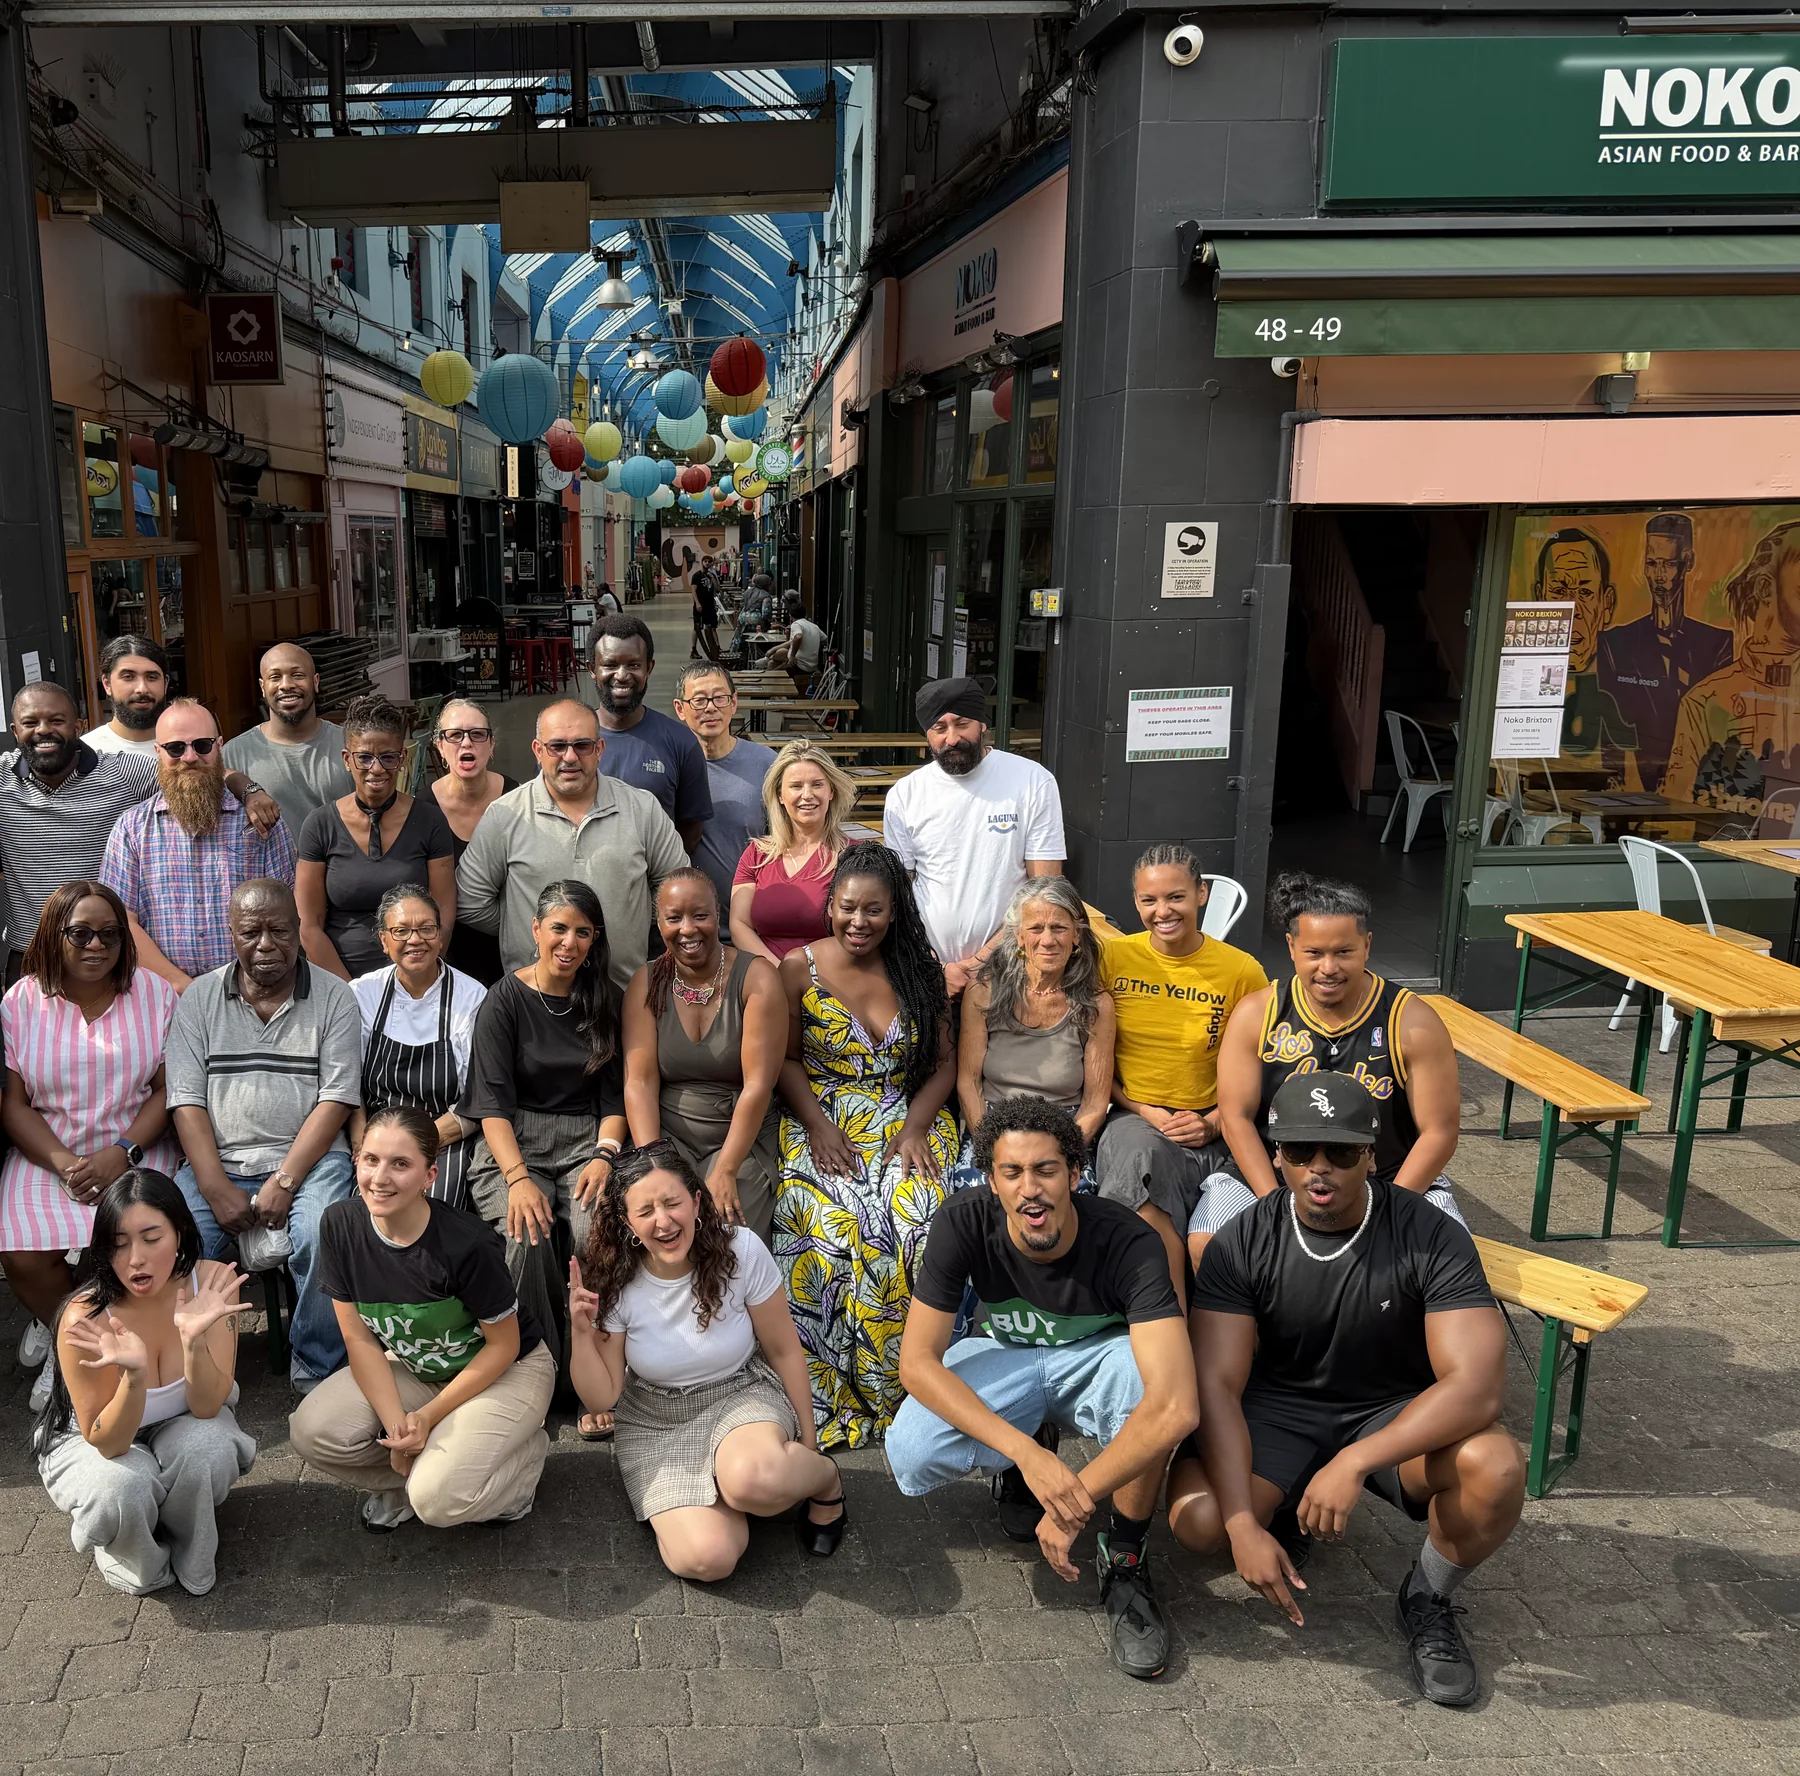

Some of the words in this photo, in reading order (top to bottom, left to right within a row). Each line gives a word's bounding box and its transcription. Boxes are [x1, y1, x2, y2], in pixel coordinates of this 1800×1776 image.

[1600, 67, 1800, 127] NOKO
[1598, 146, 1662, 163] ASIAN
[1670, 145, 1730, 162] FOOD
[1737, 145, 1751, 161] &
[1759, 144, 1799, 161] BAR
[955, 248, 997, 310] NOKO
[1255, 318, 1287, 341] 48
[1309, 317, 1342, 340] 49
[216, 351, 273, 363] KAOSARN
[1136, 690, 1180, 700] BRIXTON
[1183, 688, 1223, 698] VILLAGE
[1133, 750, 1177, 760] BRIXTON
[1180, 747, 1220, 759] VILLAGE
[988, 814, 1018, 823] LAGUNA
[1130, 979, 1160, 995] The
[1164, 983, 1226, 1005] Yellow
[1207, 1006, 1224, 1051] Pages
[1262, 1022, 1314, 1063] Los
[359, 1315, 414, 1339] BUY
[990, 1311, 1057, 1336] BUY
